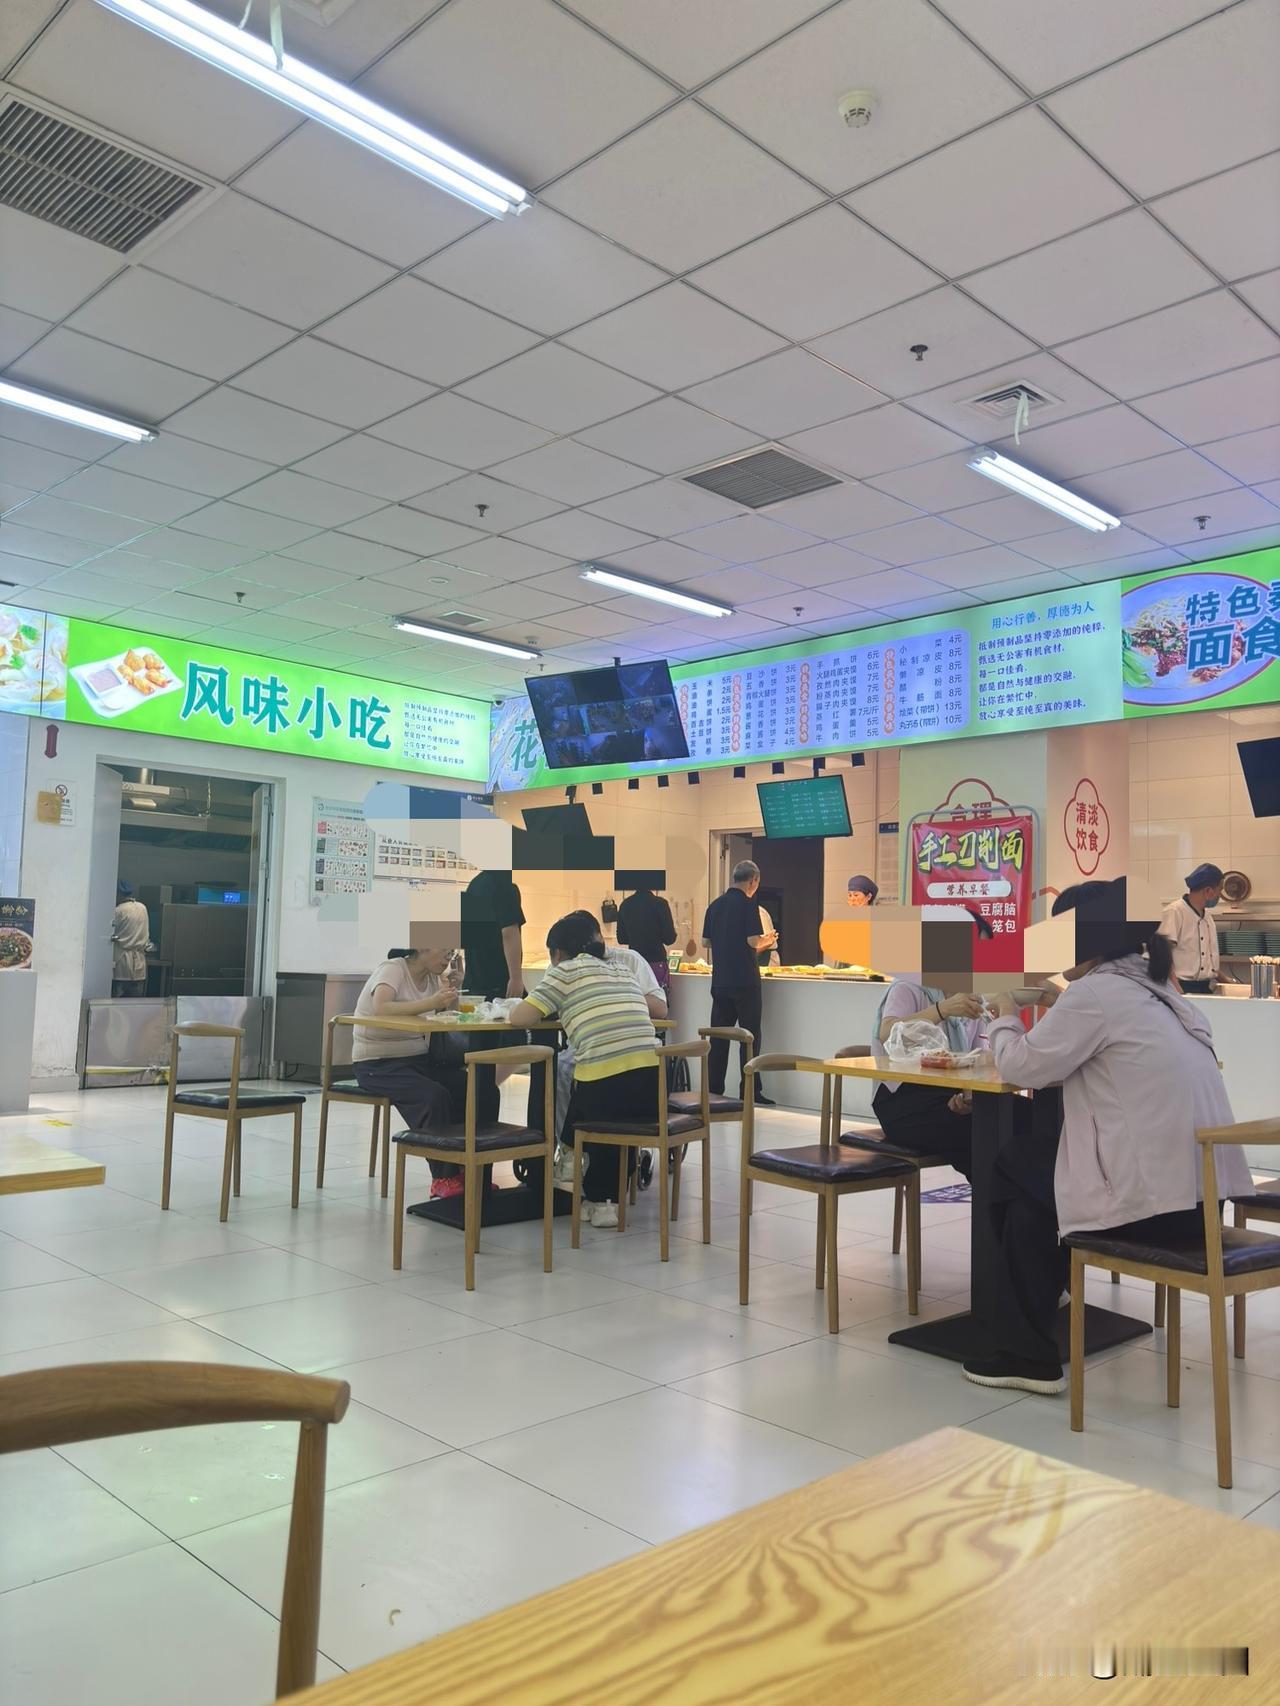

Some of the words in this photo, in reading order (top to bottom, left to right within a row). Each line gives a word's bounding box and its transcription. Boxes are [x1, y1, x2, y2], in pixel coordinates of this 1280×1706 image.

[948, 634, 962, 644] 4元
[1186, 616, 1280, 671] 面食
[948, 648, 962, 658] 8元
[948, 661, 962, 671] 8元
[867, 672, 880, 682] 7元
[948, 674, 962, 684] 8元
[867, 683, 880, 693] 7元
[948, 687, 962, 697] 8元
[867, 694, 880, 704] 8元
[180, 660, 393, 750] 风味小吃
[945, 700, 962, 710] 13元
[945, 714, 962, 724] 10元
[867, 727, 880, 737] 5元
[1076, 802, 1100, 826] 清淡
[1076, 830, 1099, 852] 饮食
[918, 826, 1024, 874] 手工刀削面
[946, 884, 991, 896] 营养早餐
[980, 904, 1016, 917] 豆腐脑
